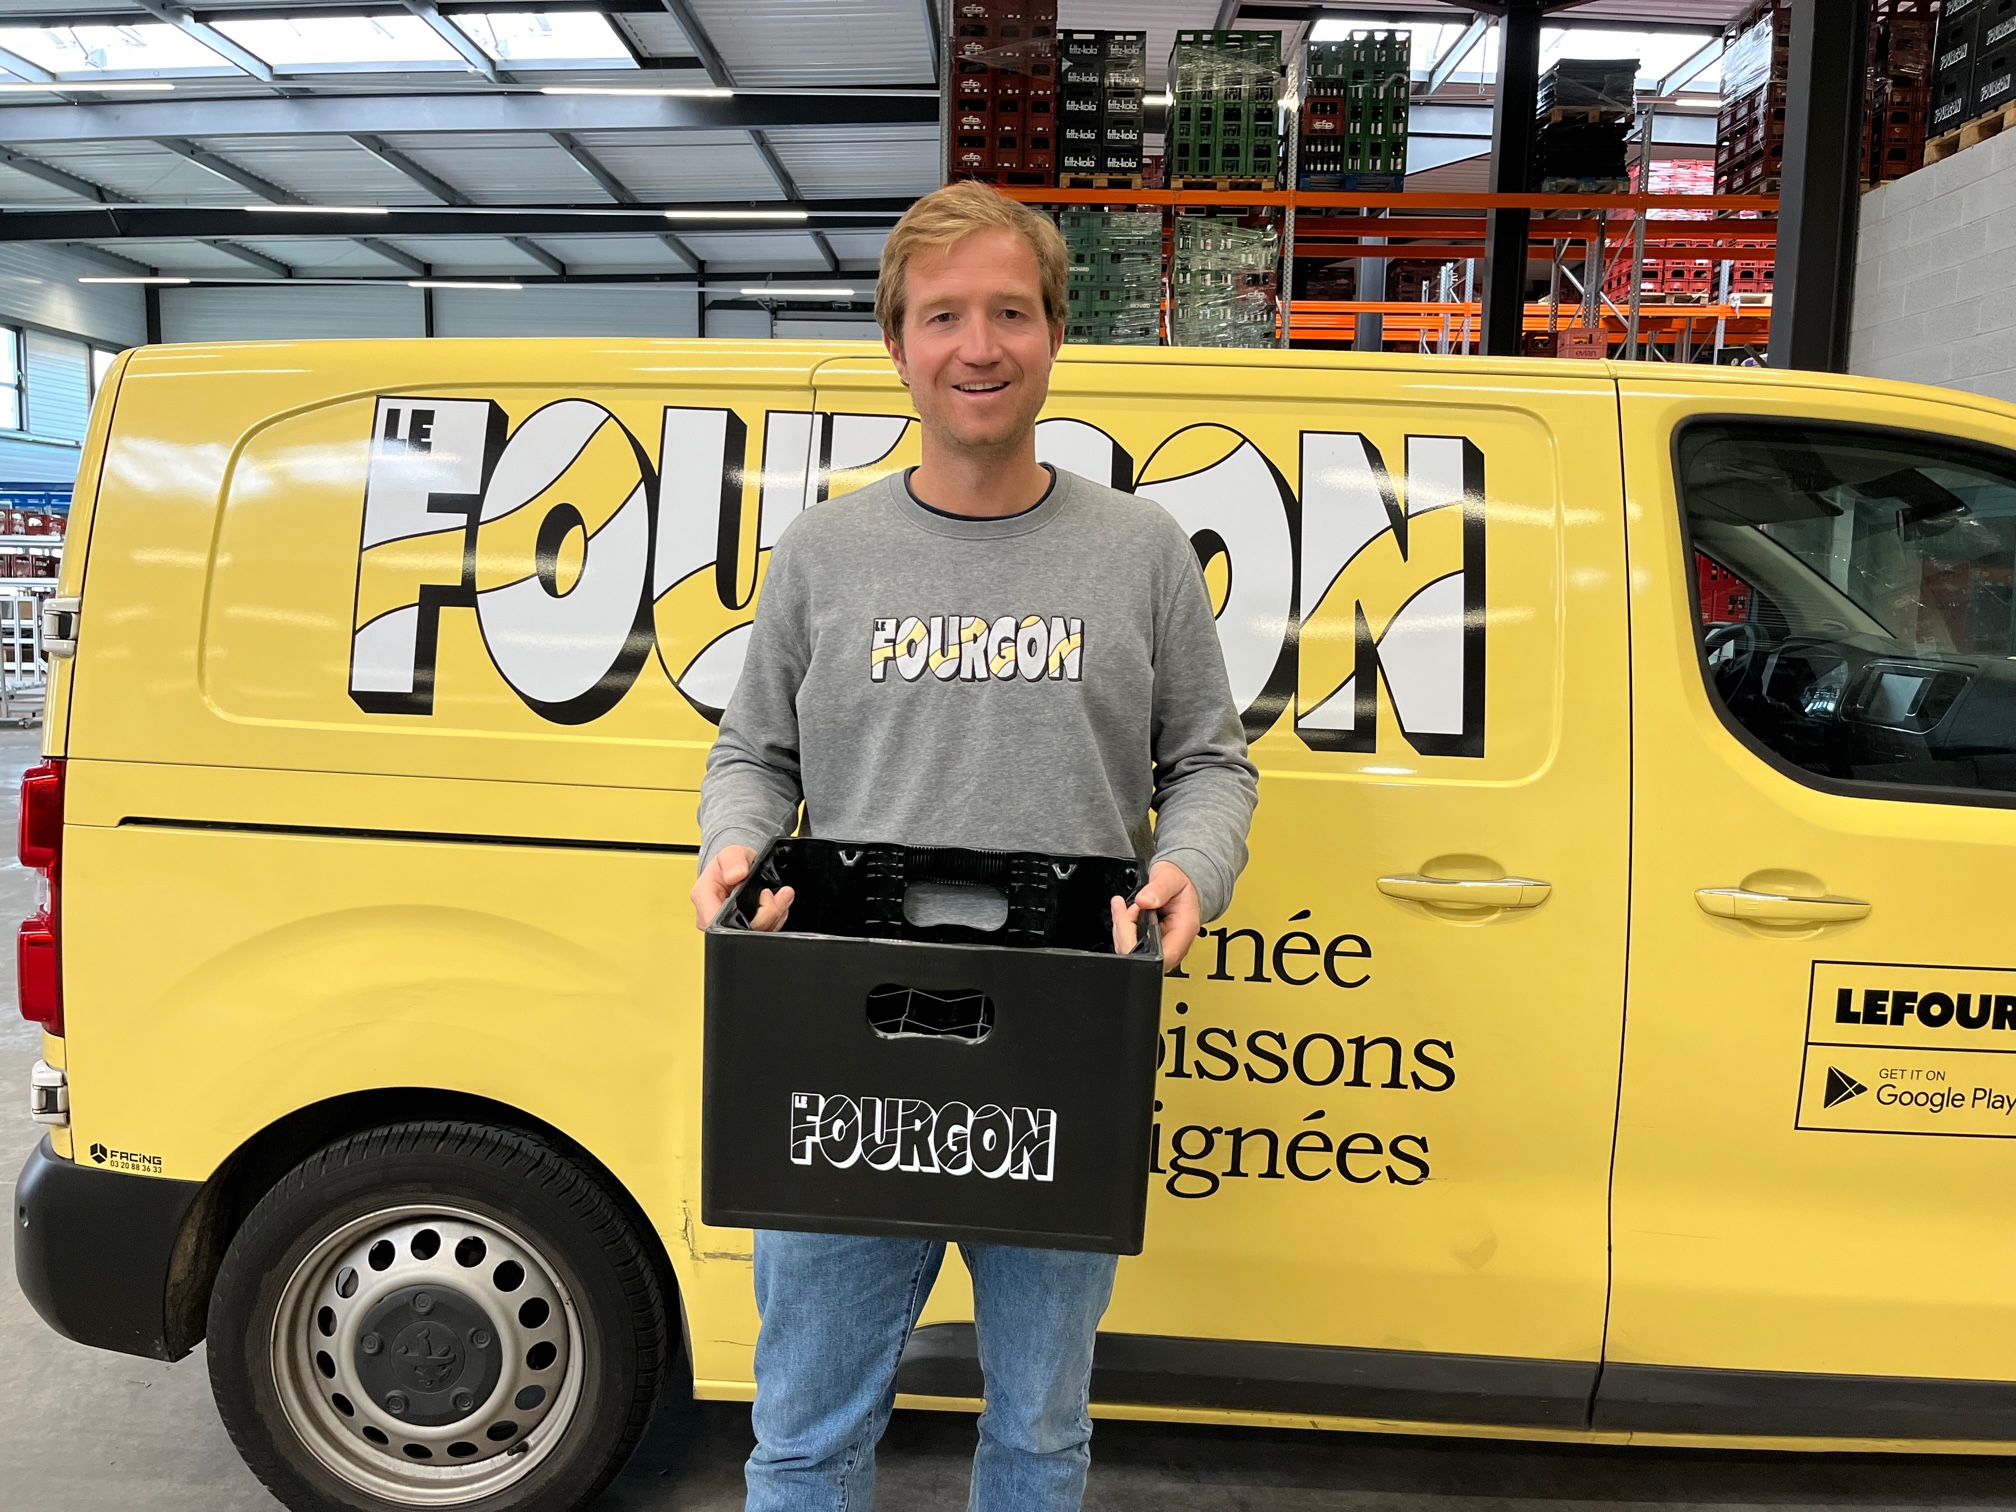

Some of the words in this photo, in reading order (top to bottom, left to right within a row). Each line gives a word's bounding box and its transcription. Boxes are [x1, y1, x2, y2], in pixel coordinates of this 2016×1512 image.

[1069, 44, 1099, 54] fritz-kola
[1068, 72, 1098, 82] fritz-kola
[1066, 100, 1098, 111] fritz-kola
[1108, 99, 1138, 110] fritz-kola
[1066, 129, 1097, 139] fritz-kola
[1107, 129, 1139, 139] fritz-kola
[1064, 156, 1096, 167] fritz-kola
[1107, 157, 1138, 168] fritz-kola
[1575, 349, 1597, 357] evian
[383, 408, 435, 453] LE
[875, 621, 887, 632] LE
[871, 615, 1085, 682] FOURGON
[1157, 1002, 1456, 1092] issons
[1879, 1068, 1907, 1080] GET
[1911, 1070, 1922, 1080] IT
[1926, 1070, 1946, 1081] ON
[795, 1095, 808, 1109] LE
[1876, 1084, 1966, 1113] Google
[1972, 1087, 2016, 1115] Play
[791, 1092, 1057, 1181] FOURGON
[110, 1160, 119, 1168] 03
[120, 1161, 130, 1170] 20
[131, 1163, 140, 1171] 88
[142, 1164, 151, 1172] 36
[153, 1166, 162, 1174] 33
